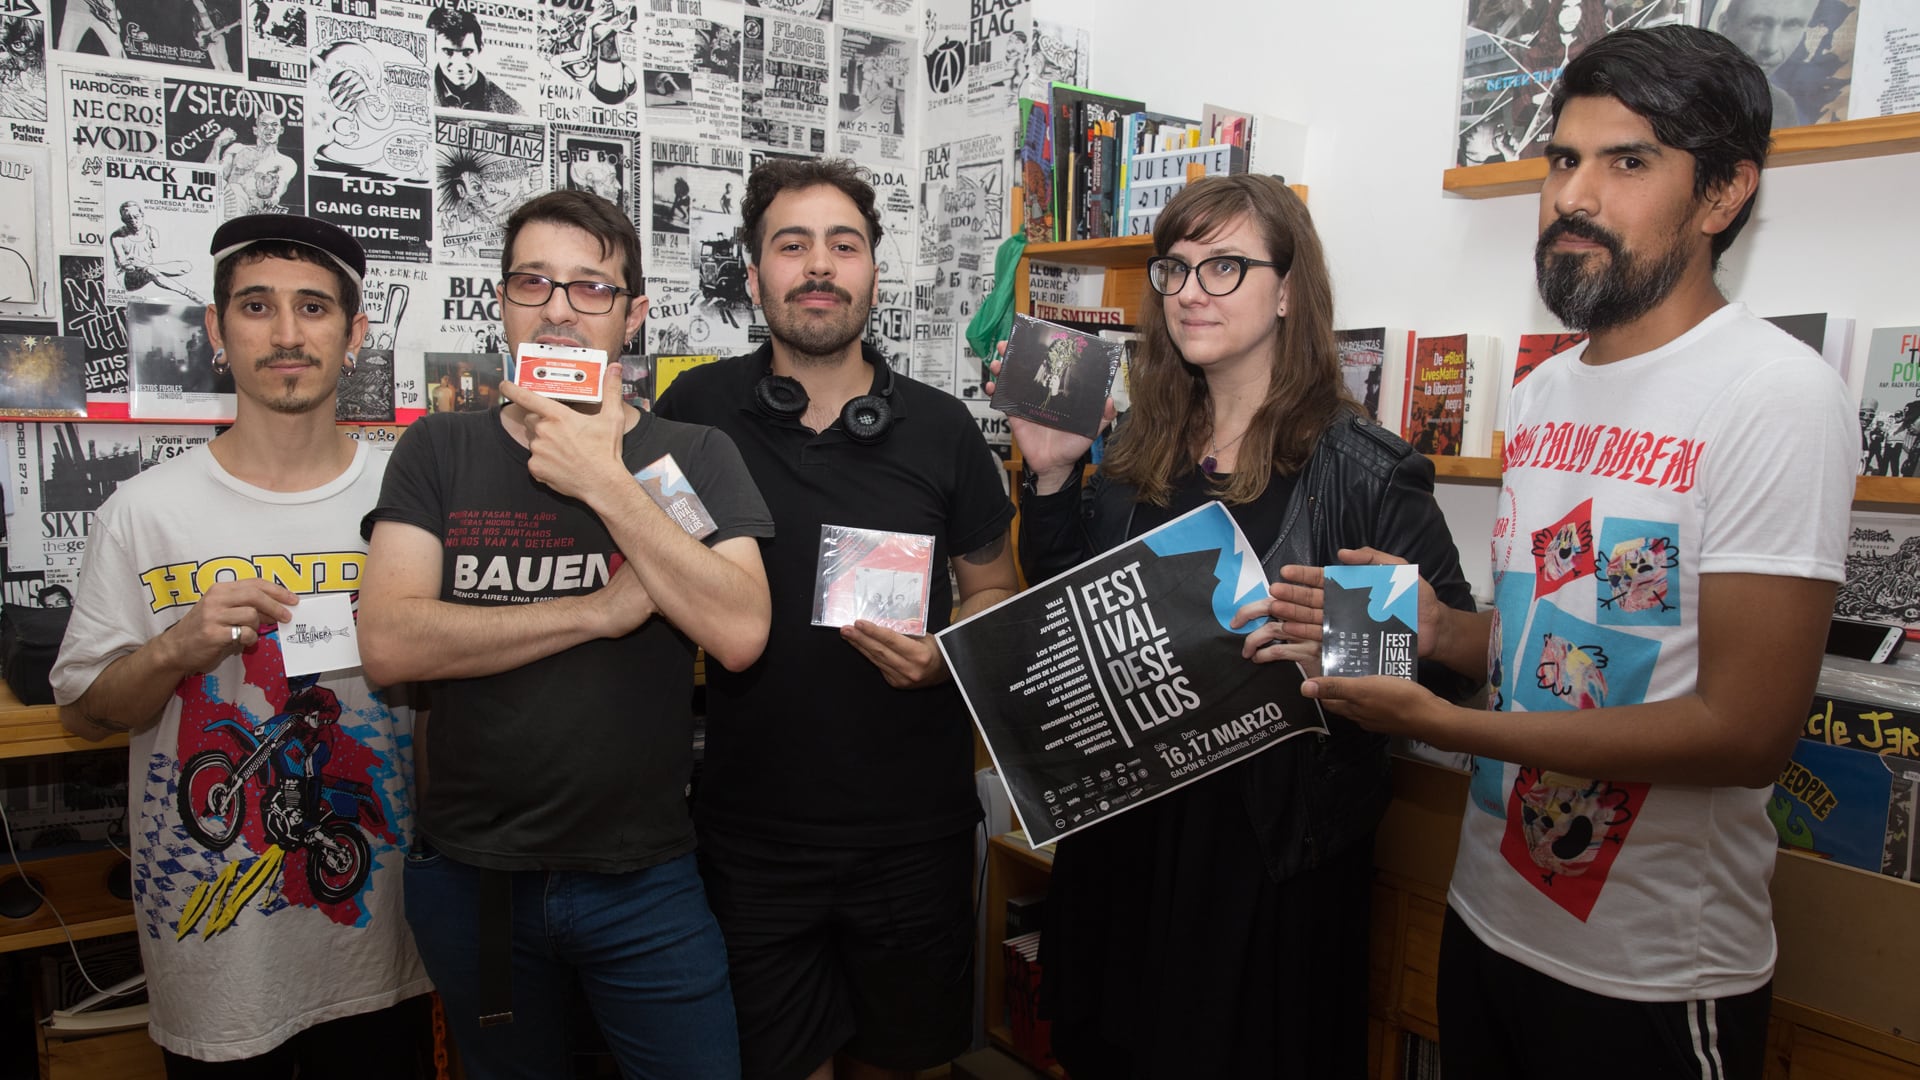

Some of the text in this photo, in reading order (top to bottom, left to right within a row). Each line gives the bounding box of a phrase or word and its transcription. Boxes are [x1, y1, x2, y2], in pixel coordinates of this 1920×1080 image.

[457, 0, 534, 21] APPROACH
[773, 20, 825, 44] FLOOR
[970, 8, 1014, 43] FLAG
[772, 36, 825, 60] PUNCH
[70, 79, 149, 97] HARDCORE
[540, 83, 583, 100] VERMIN
[188, 85, 304, 120] SECONDS
[10, 123, 45, 135] Perkins
[200, 118, 222, 139] 25
[838, 119, 856, 130] MAY
[878, 121, 889, 133] 30
[13, 132, 43, 143] Palace
[106, 156, 171, 166] CLIMAX PRESENTS
[669, 143, 699, 163] PEOPLE
[106, 162, 177, 183] BLACK
[873, 172, 908, 187] D.O.A.
[162, 183, 214, 202] FLAG
[144, 199, 186, 208] WEDNESDAY
[316, 201, 421, 220] GANG GREEN
[445, 234, 482, 245] OLYMPIC
[652, 233, 678, 248] DOM 24
[1043, 266, 1062, 278] OUR
[363, 290, 385, 300] TOUR
[1050, 293, 1065, 304] DIE
[365, 302, 382, 311] 1993
[1037, 304, 1120, 324] THE SMITHS
[1434, 352, 1443, 366] De
[1421, 367, 1460, 381] LivesMatter
[157, 392, 183, 400] SONIDOS
[155, 437, 182, 445] YOUTH
[482, 511, 511, 519] PASAR
[514, 512, 528, 520] MIL
[41, 512, 78, 538] SIX
[482, 528, 500, 536] NOS
[504, 528, 552, 538] JUNTAMOS
[485, 538, 507, 547] VAN
[525, 537, 575, 549] DETENER
[481, 592, 508, 602] AIRES
[511, 595, 530, 603] UNA
[1081, 561, 1148, 621] FEST
[1045, 597, 1064, 610] VALLE
[1039, 616, 1070, 635] JUVENILIA
[1093, 602, 1167, 658] IVAL
[1036, 635, 1076, 658] LOS POSIBLES
[1386, 633, 1412, 647] FEST
[1052, 645, 1079, 662] MARTON
[1385, 647, 1412, 661] IVAL
[1107, 637, 1183, 697] DESE
[1385, 662, 1412, 675] DESE
[1023, 663, 1086, 696] CON LOS ESQUIMALES
[1051, 673, 1088, 694] LOS NEGROS
[1060, 682, 1092, 702] BAUMANN
[1063, 692, 1096, 711] FEMINOISE
[1126, 675, 1201, 732] LLOS
[1040, 701, 1100, 731] HIROSHIMA DANDYS
[1069, 710, 1104, 729] LOS SAGAN
[1044, 720, 1108, 751] GENTE CONVERSANDO
[1160, 746, 1186, 768] 16
[1188, 732, 1211, 756] 17
[1211, 702, 1283, 746] MARZO
[1180, 729, 1199, 741] Dom.
[1154, 741, 1170, 752] Sáb.
[1170, 760, 1199, 779] GALPÓN
[1207, 741, 1250, 763] Cochabamba
